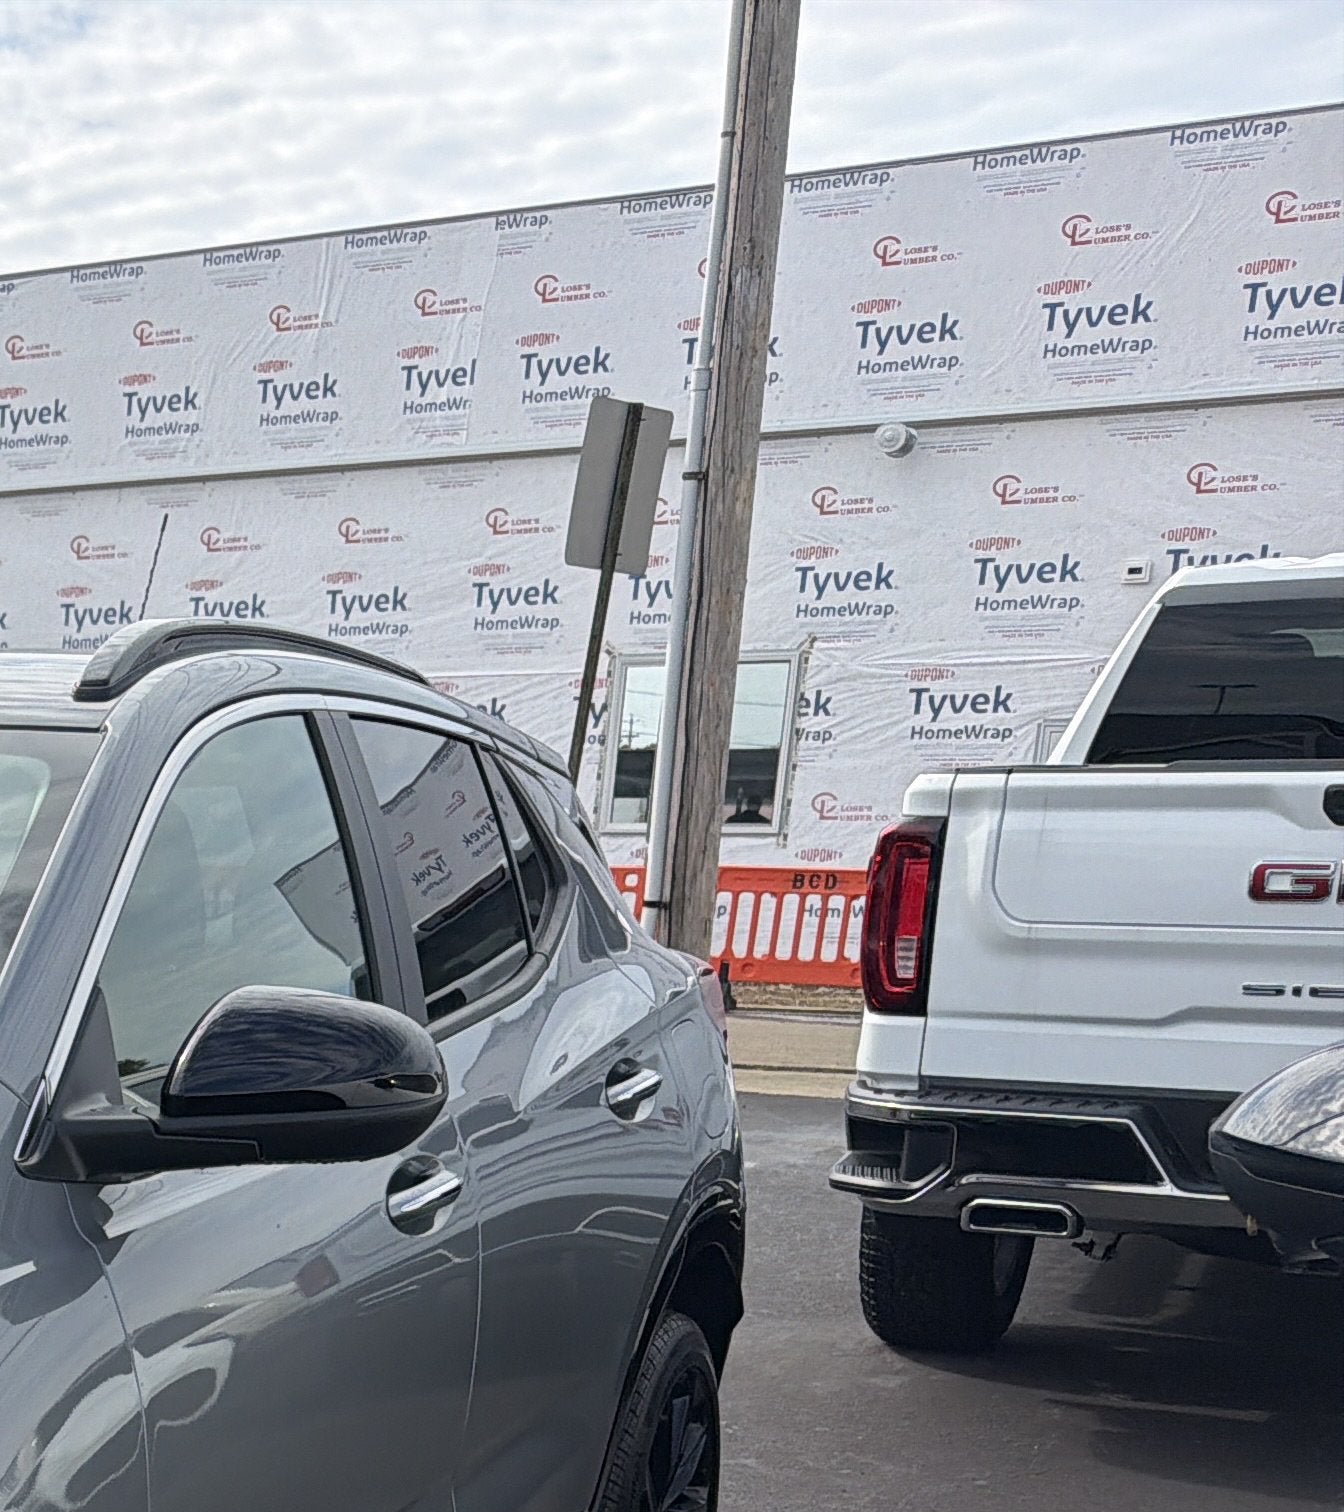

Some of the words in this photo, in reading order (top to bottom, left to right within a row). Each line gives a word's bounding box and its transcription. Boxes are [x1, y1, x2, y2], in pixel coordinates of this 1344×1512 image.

[1169, 121, 1287, 147] HomeWrap
[972, 145, 1085, 169] HomeWrap
[789, 169, 892, 193] HomeWrap
[619, 194, 713, 213] HomeWrap
[344, 231, 427, 248] HomeWrap
[202, 245, 281, 268] HomeWrap
[70, 266, 143, 282] HomeWrap
[1245, 259, 1290, 275] DUPONT
[1043, 280, 1086, 295] DUPONT
[857, 299, 896, 314] DUPONT
[1243, 276, 1344, 320] Tyve
[1042, 293, 1153, 339] Tyvek
[521, 333, 555, 347] DUPONT
[856, 312, 959, 356] Tyvek
[402, 345, 434, 359] DUPONT
[1043, 337, 1152, 359] HomeWrap
[258, 360, 288, 373] DUPONT
[520, 346, 613, 386] Tyvek
[857, 354, 959, 375] HomeWrap
[257, 373, 337, 410] Tyvek
[123, 386, 198, 422] Tyvek
[260, 409, 342, 427] HomeWrap
[125, 421, 199, 438] HomeWrap
[1168, 527, 1211, 542] DUPONT
[796, 546, 834, 560] DUPONT
[975, 537, 1016, 551] DUPONT
[327, 571, 358, 584] DUPONT
[473, 563, 505, 577] DUPONT
[974, 553, 1080, 593] Tyvek
[795, 562, 894, 600] Tyvek
[326, 586, 407, 621] Tyvek
[472, 579, 559, 614] Tyvek
[975, 594, 1080, 612] HomeWrap
[60, 600, 132, 630] Tyvek
[796, 602, 894, 618] HomeWrap
[328, 622, 408, 637] HomeWrap
[474, 615, 559, 631] HomeWrap
[911, 668, 950, 681] DUPONT
[909, 685, 1013, 723] Tyvek
[910, 724, 1013, 742] HomeWrap
[800, 848, 837, 862] DUPONT
[792, 873, 838, 890] BCD
